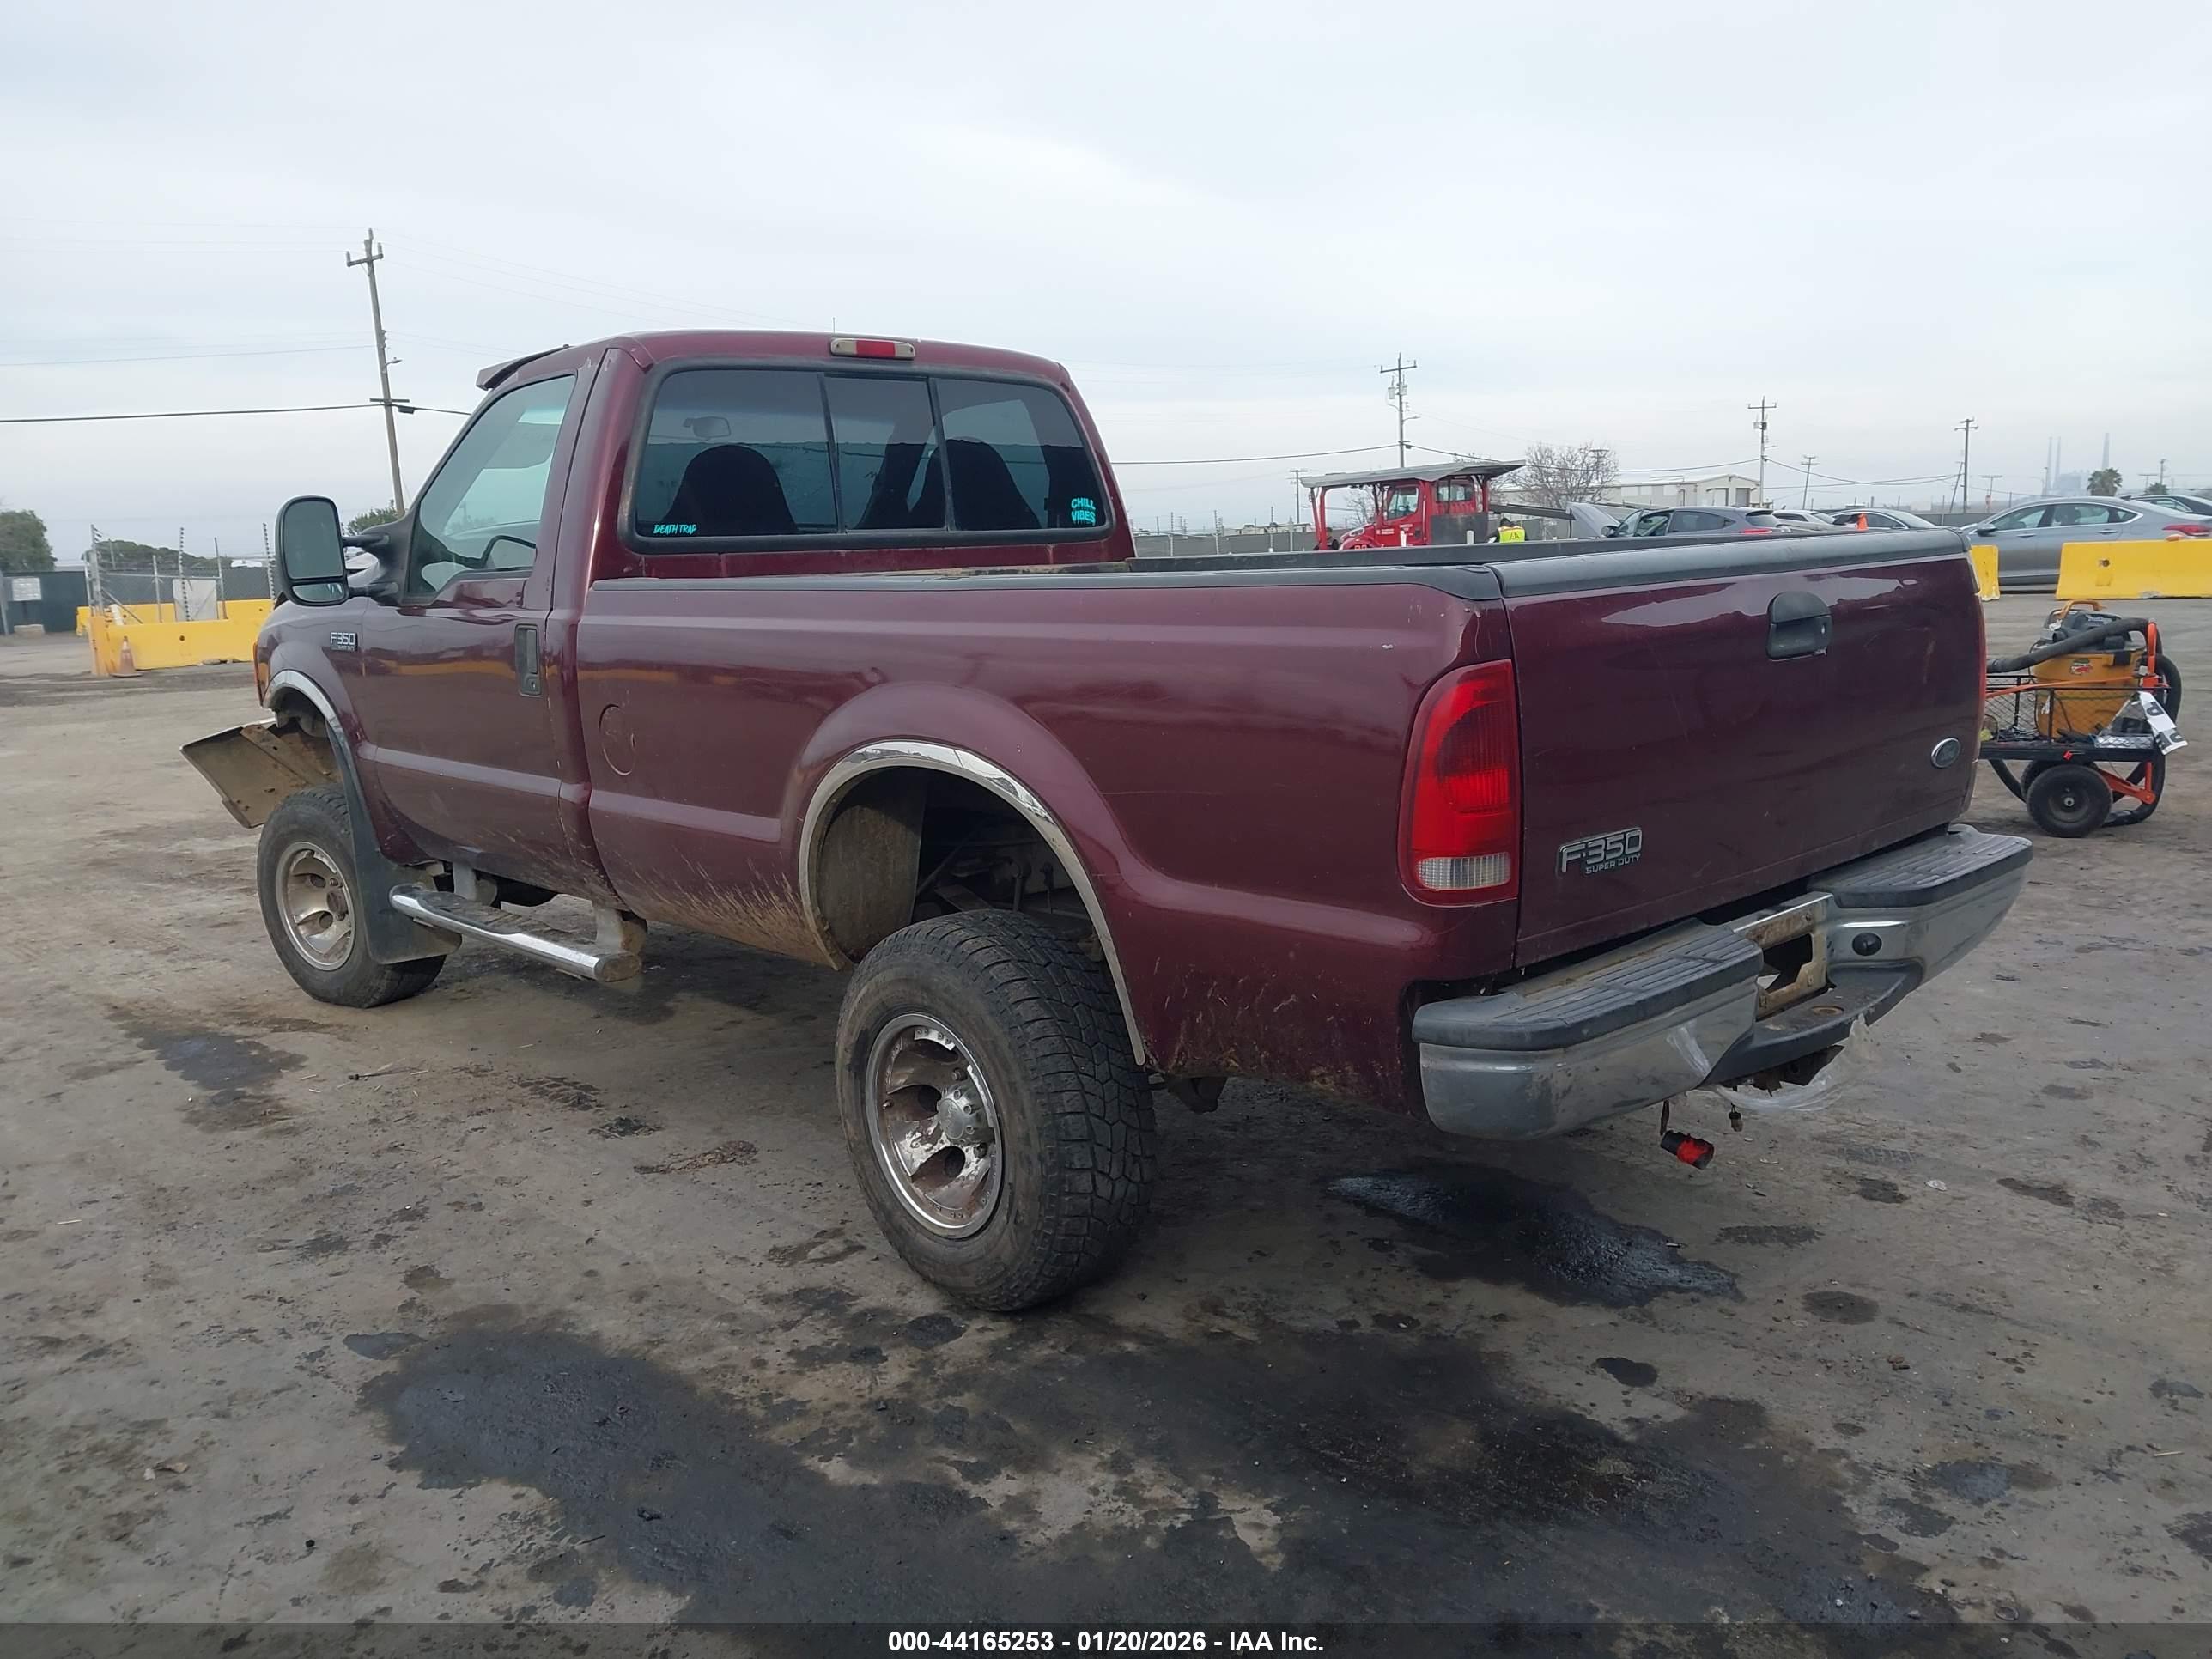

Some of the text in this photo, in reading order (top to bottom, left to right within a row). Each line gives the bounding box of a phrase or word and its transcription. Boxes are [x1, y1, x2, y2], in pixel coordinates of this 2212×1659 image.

[1071, 497, 1096, 509] CHILL
[1071, 510, 1096, 526] VIBES
[653, 524, 696, 534] DEATH TRAP
[1585, 853, 1641, 874] SUPER DUTY
